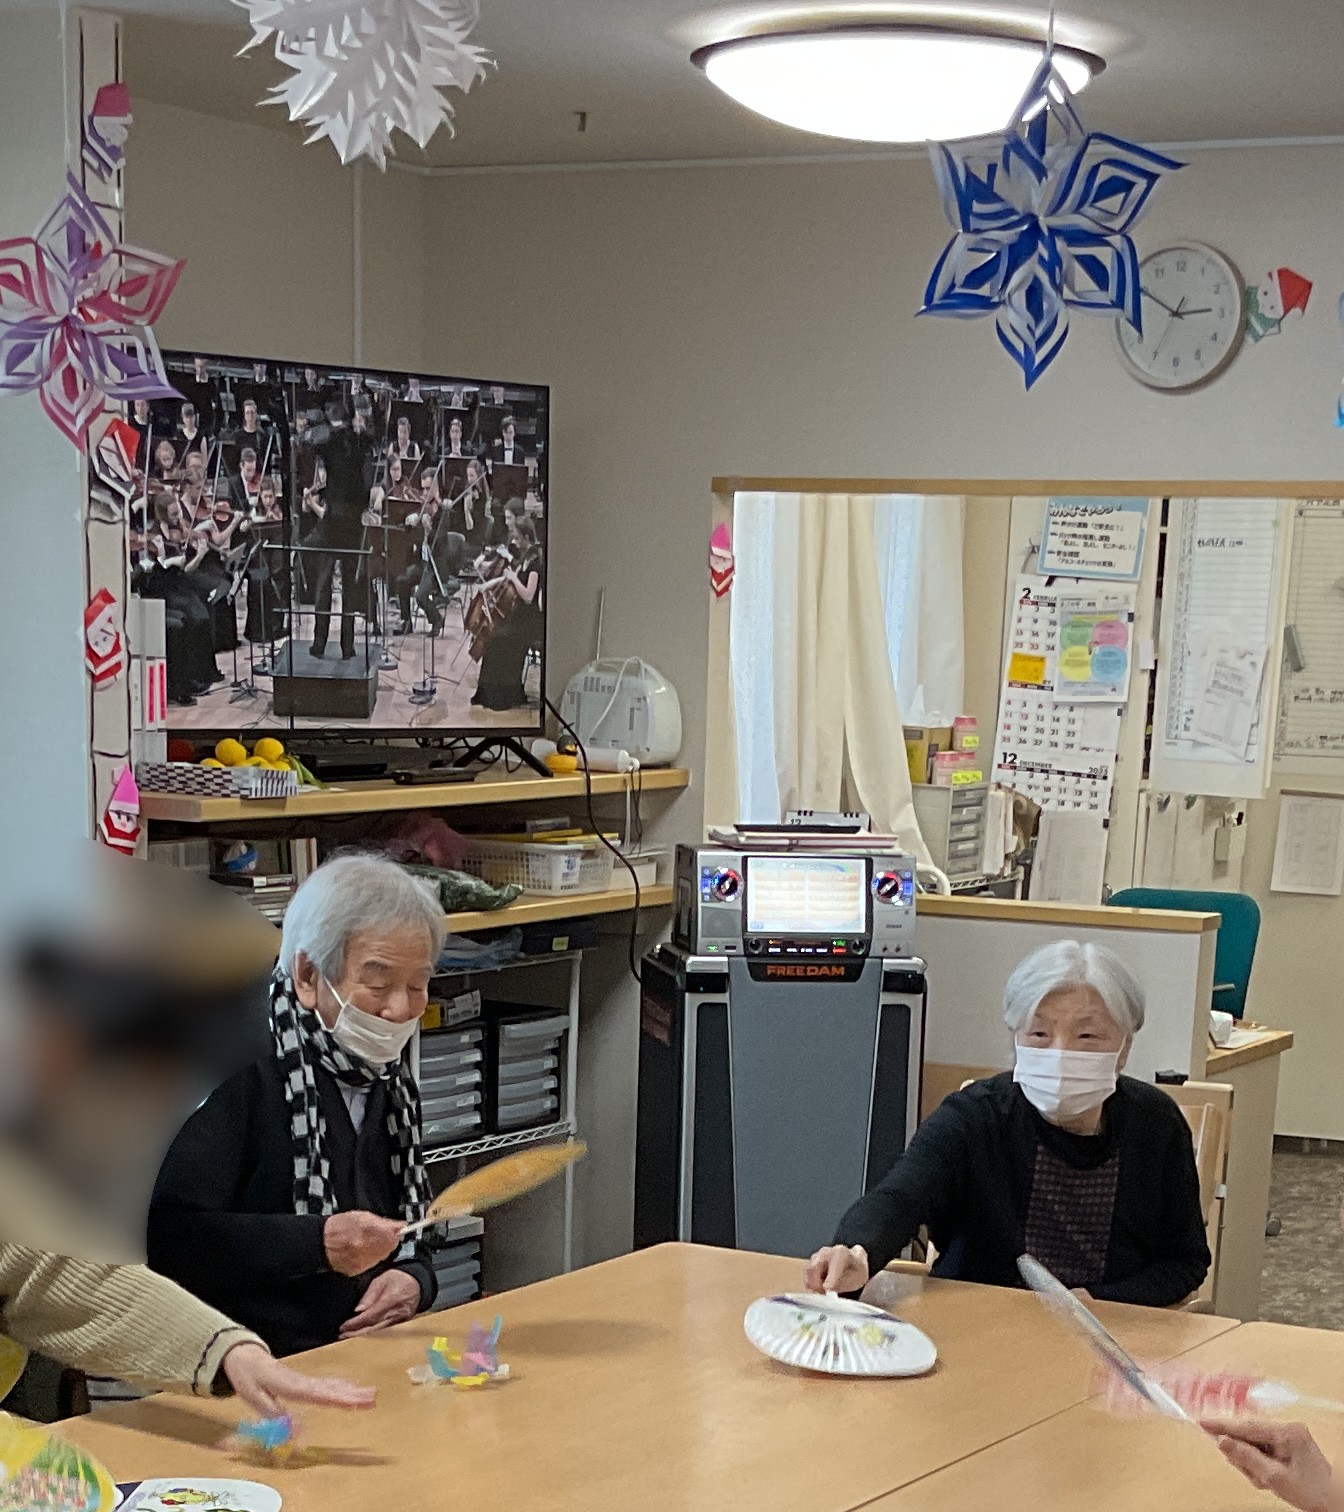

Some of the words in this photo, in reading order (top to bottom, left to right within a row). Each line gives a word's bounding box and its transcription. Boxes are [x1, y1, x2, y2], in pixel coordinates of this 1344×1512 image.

[1176, 261, 1187, 272] 12
[1156, 269, 1165, 279] 11
[1213, 285, 1220, 294] 2
[1211, 332, 1218, 342] 4
[1194, 350, 1201, 360] 5
[1173, 357, 1179, 368] 6
[1022, 587, 1032, 600] 2
[1002, 752, 1017, 764] 12
[1020, 760, 1052, 768] DECEMBER
[766, 965, 845, 976] FREEDAM
